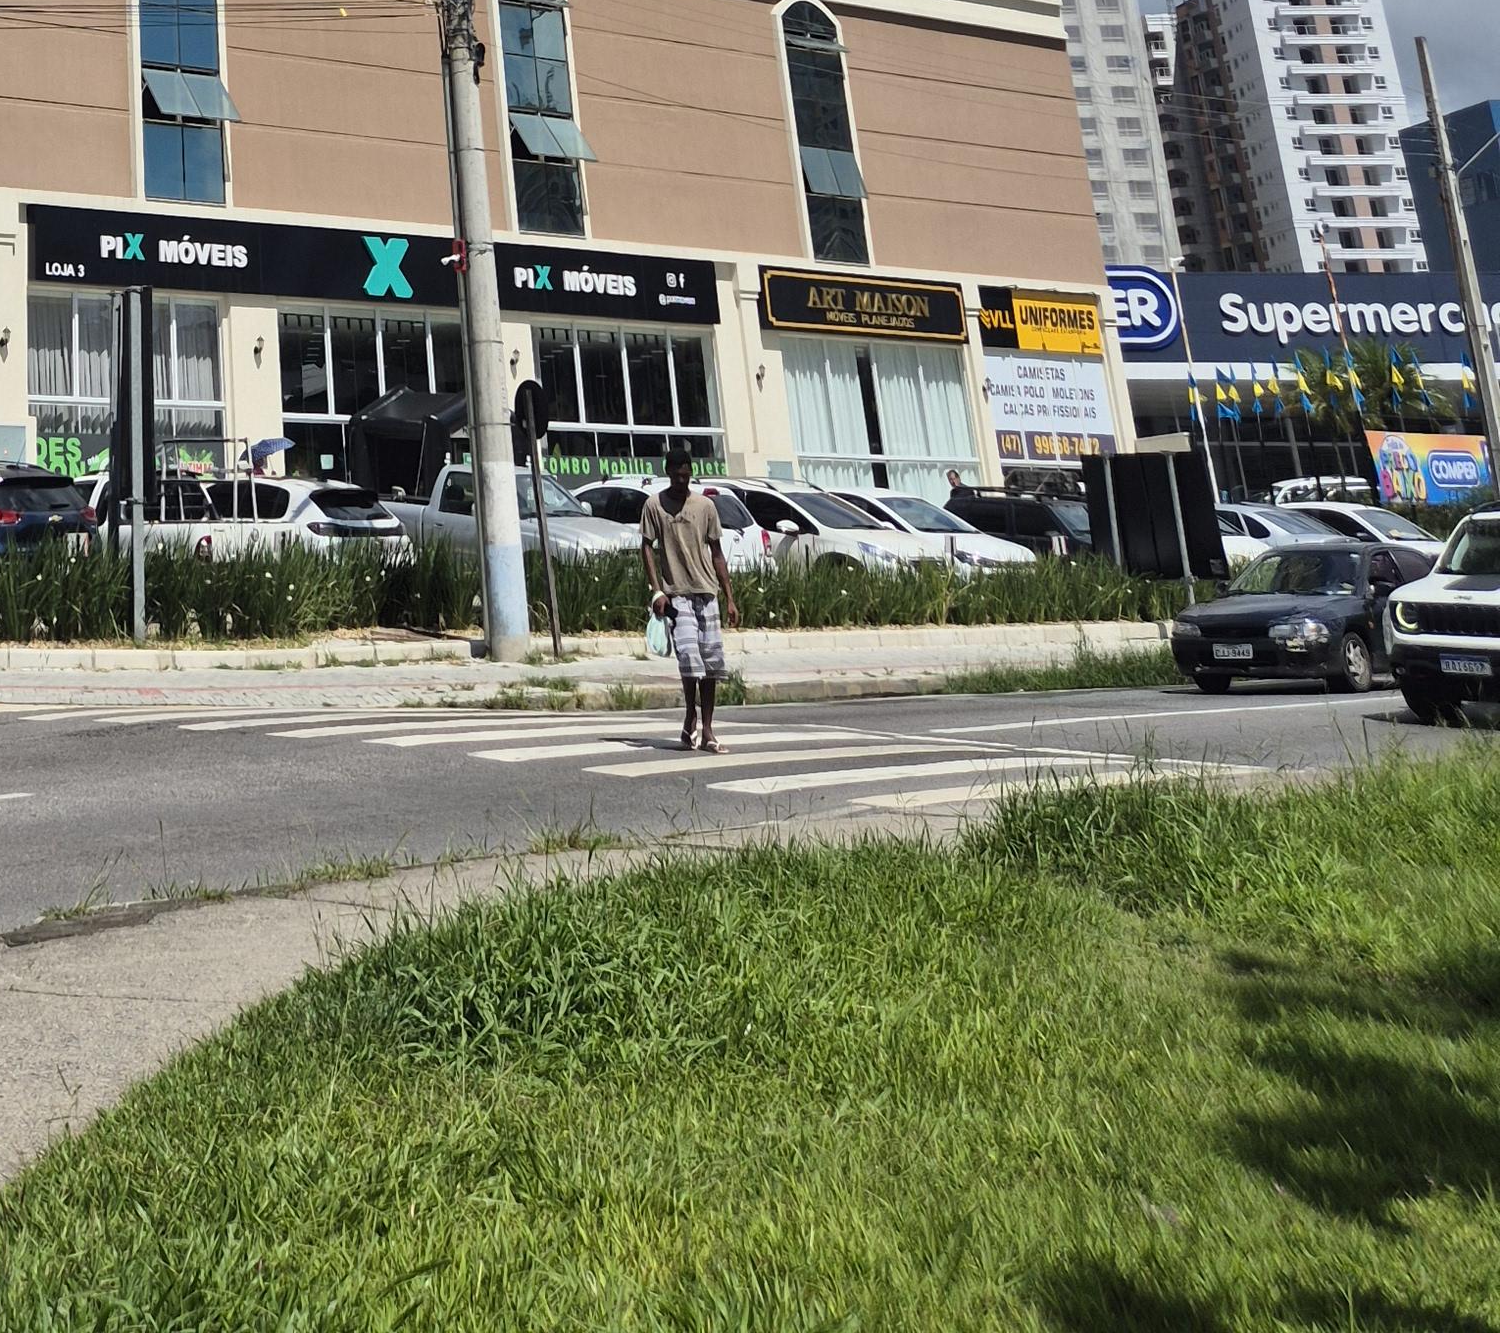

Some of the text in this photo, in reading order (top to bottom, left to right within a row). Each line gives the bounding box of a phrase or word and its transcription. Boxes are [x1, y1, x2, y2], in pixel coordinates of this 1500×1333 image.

[99, 232, 249, 269] PIX MÓVEIS
[45, 262, 86, 277] LOJA 3
[361, 235, 414, 299] X
[513, 264, 637, 297] PIX MÓVEIS
[806, 285, 931, 318] ART MAISON
[1019, 304, 1095, 331] UNIFORMES
[1219, 292, 1500, 345] Supermerc
[1023, 384, 1045, 399] POLO
[1037, 404, 1098, 420] PRFISSIOAIS
[1001, 434, 1021, 454] (47)
[1431, 459, 1478, 480] COMPER
